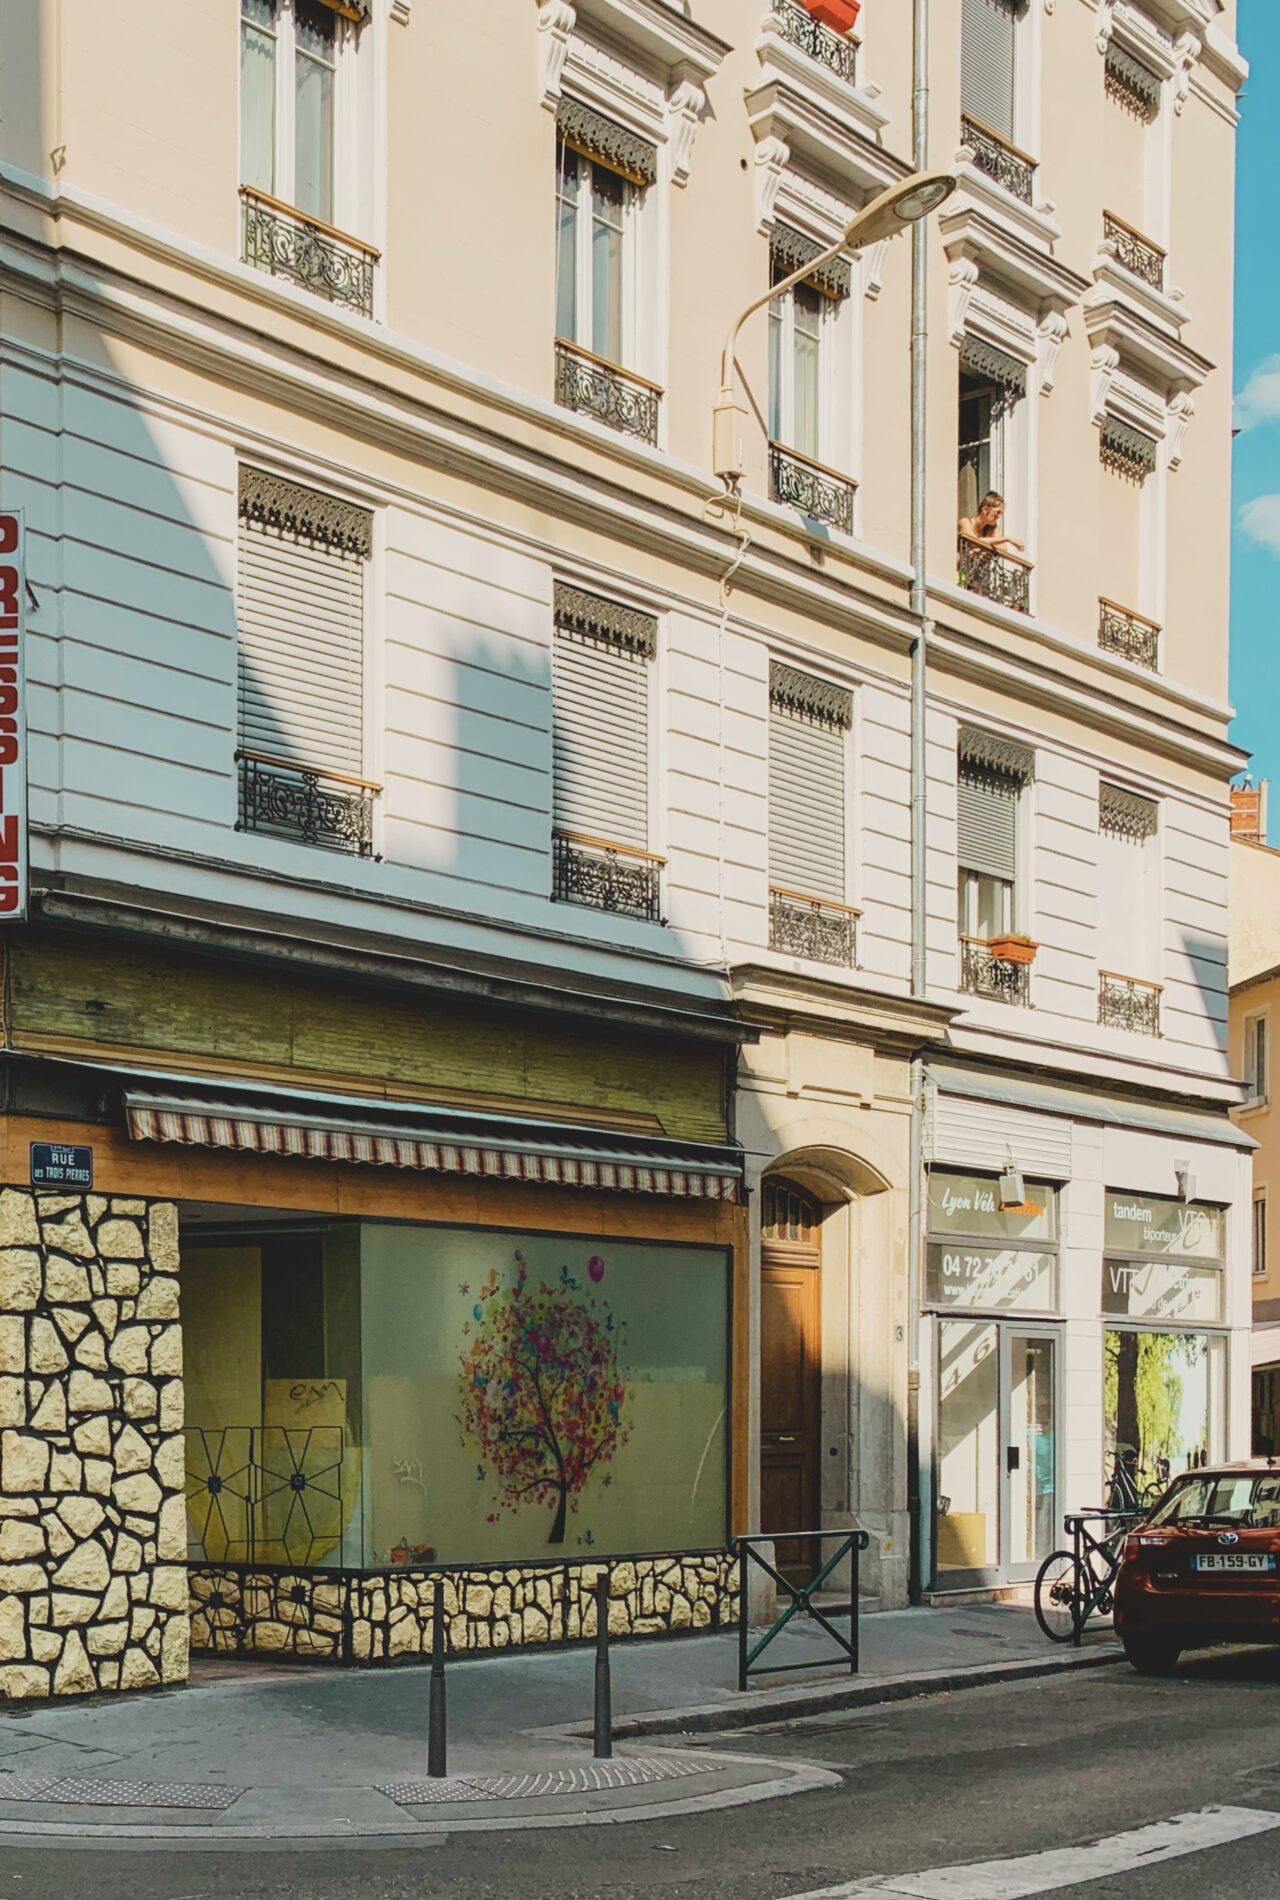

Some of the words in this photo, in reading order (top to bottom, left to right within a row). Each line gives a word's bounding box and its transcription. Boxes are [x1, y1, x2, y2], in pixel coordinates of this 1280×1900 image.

[51, 1153, 75, 1165] RUE
[34, 1168, 43, 1178] DES
[46, 1166, 64, 1180] TROIS
[65, 1168, 90, 1181] PIERRES
[941, 1186, 972, 1216] Lyon
[1113, 1201, 1152, 1222] tandem
[943, 1254, 961, 1277] 04
[964, 1256, 982, 1278] 72
[896, 1326, 903, 1341] 3
